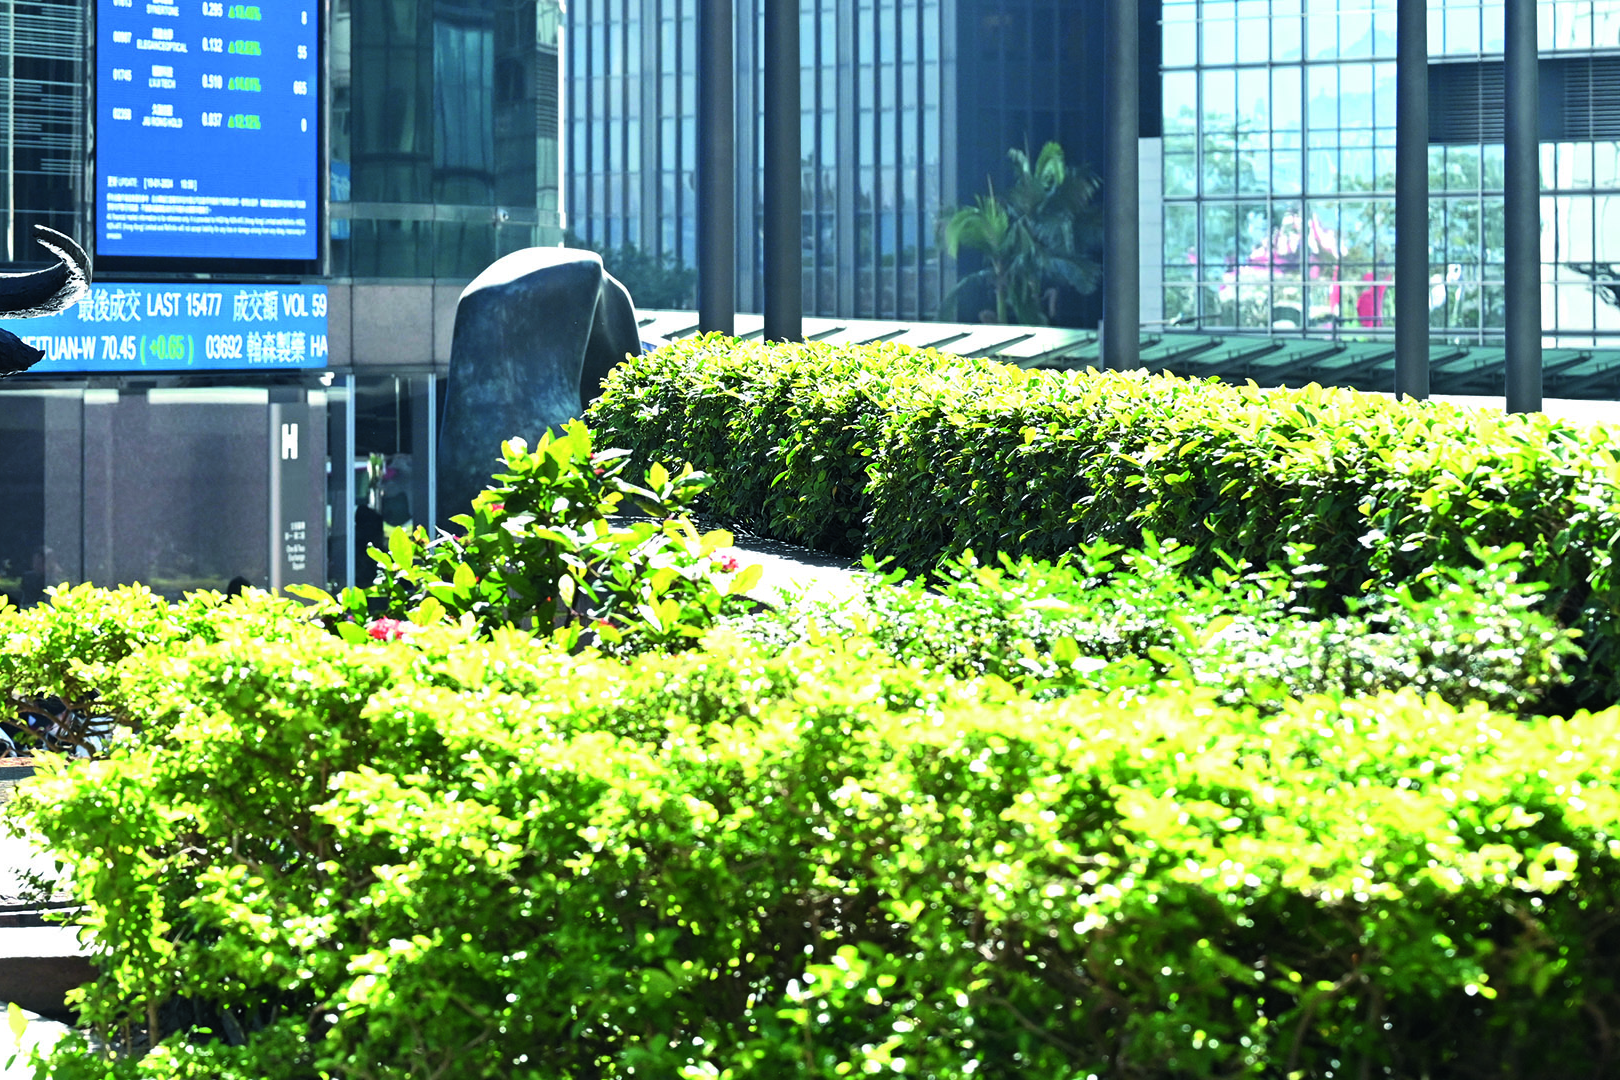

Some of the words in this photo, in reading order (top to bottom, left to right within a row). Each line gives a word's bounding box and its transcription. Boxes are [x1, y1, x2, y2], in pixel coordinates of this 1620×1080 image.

[202, 36, 223, 53] 0.132
[297, 44, 308, 60] 55
[146, 291, 182, 318] LAST
[185, 292, 223, 318] 15477
[233, 289, 279, 322] 成交額
[282, 292, 309, 318] VOL
[101, 335, 137, 361] 70.45
[205, 334, 243, 360] 03692
[281, 423, 298, 460] H
